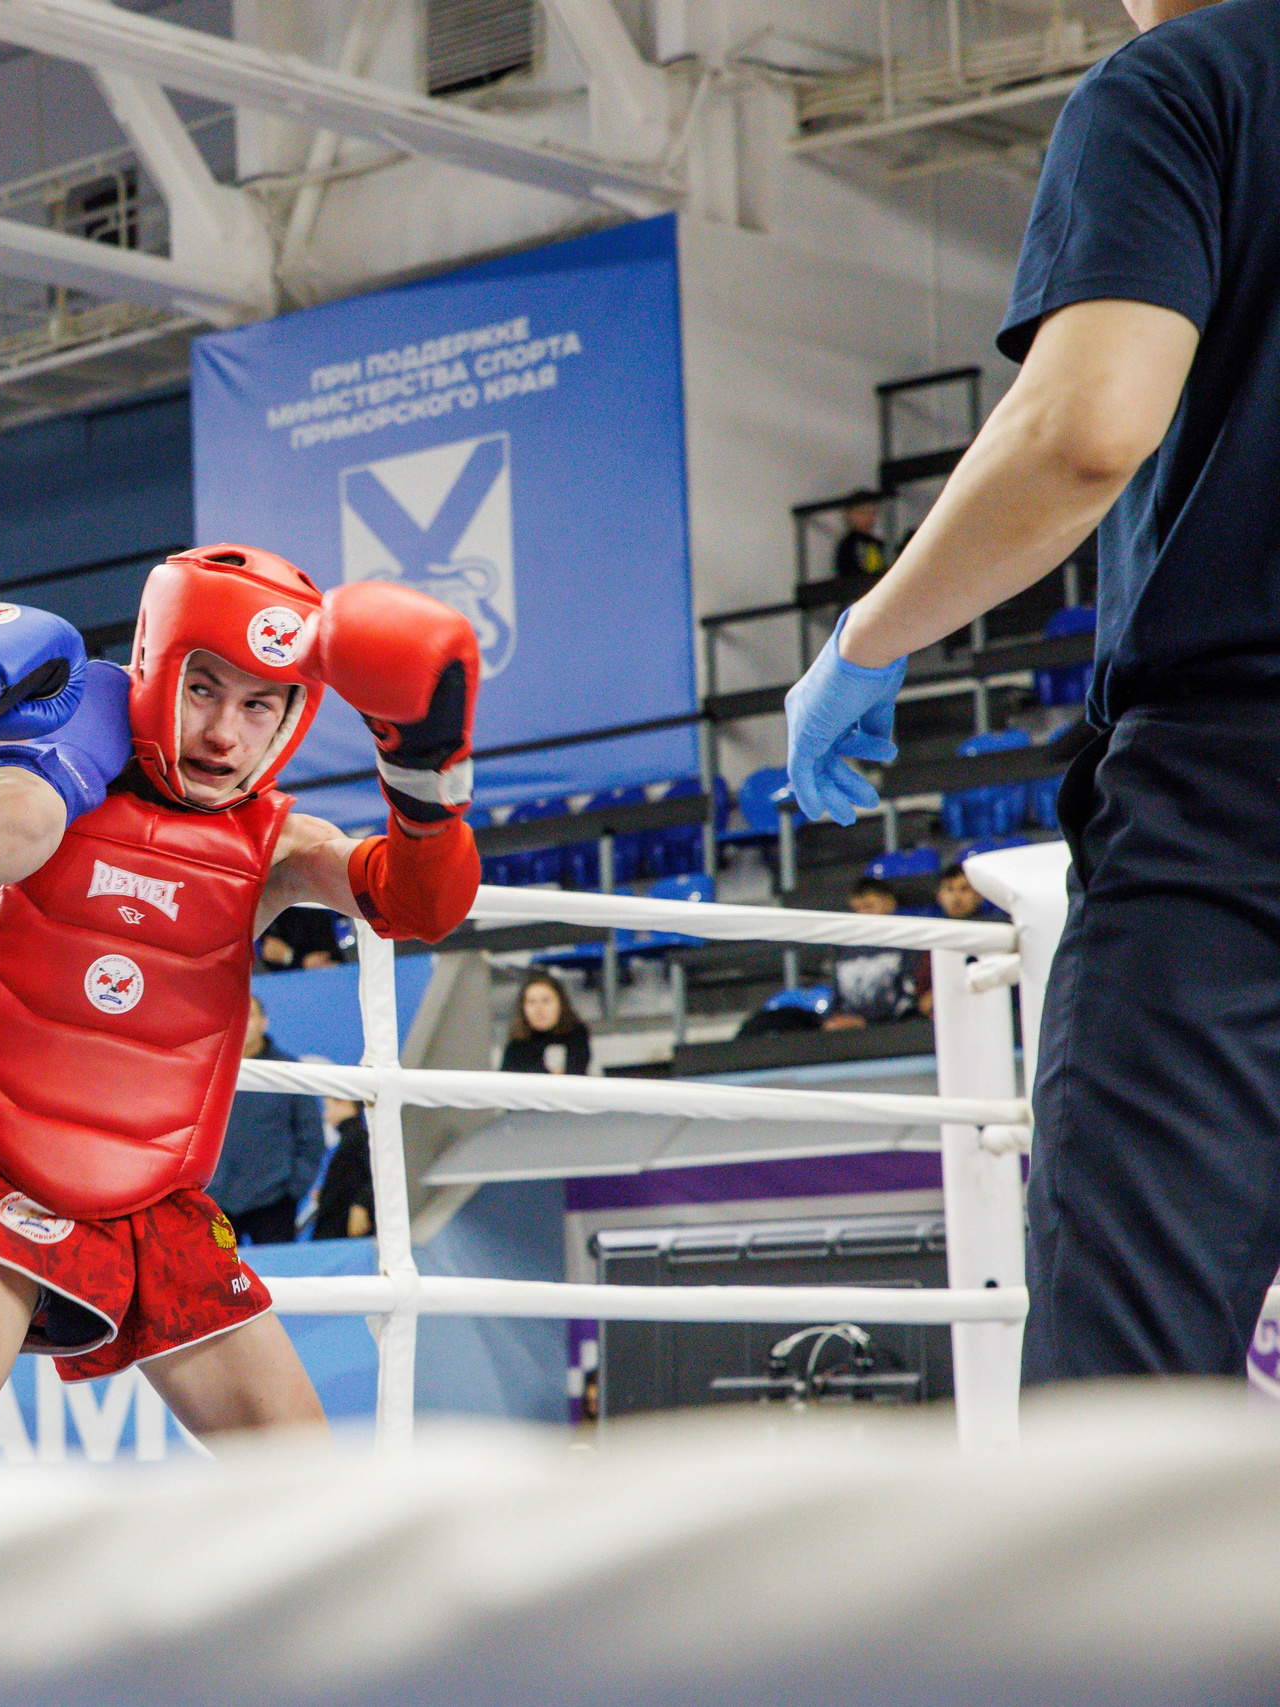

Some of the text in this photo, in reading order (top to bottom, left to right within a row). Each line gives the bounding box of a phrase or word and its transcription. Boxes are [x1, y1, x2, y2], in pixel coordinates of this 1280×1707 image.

[267, 330, 582, 429] МИНИСТЕРСТВА СПОРТА
[311, 316, 530, 392] ПРИ ПОДДЕРЖКЕ
[290, 364, 558, 449] ПРИМОРСКОГО КРАЯ
